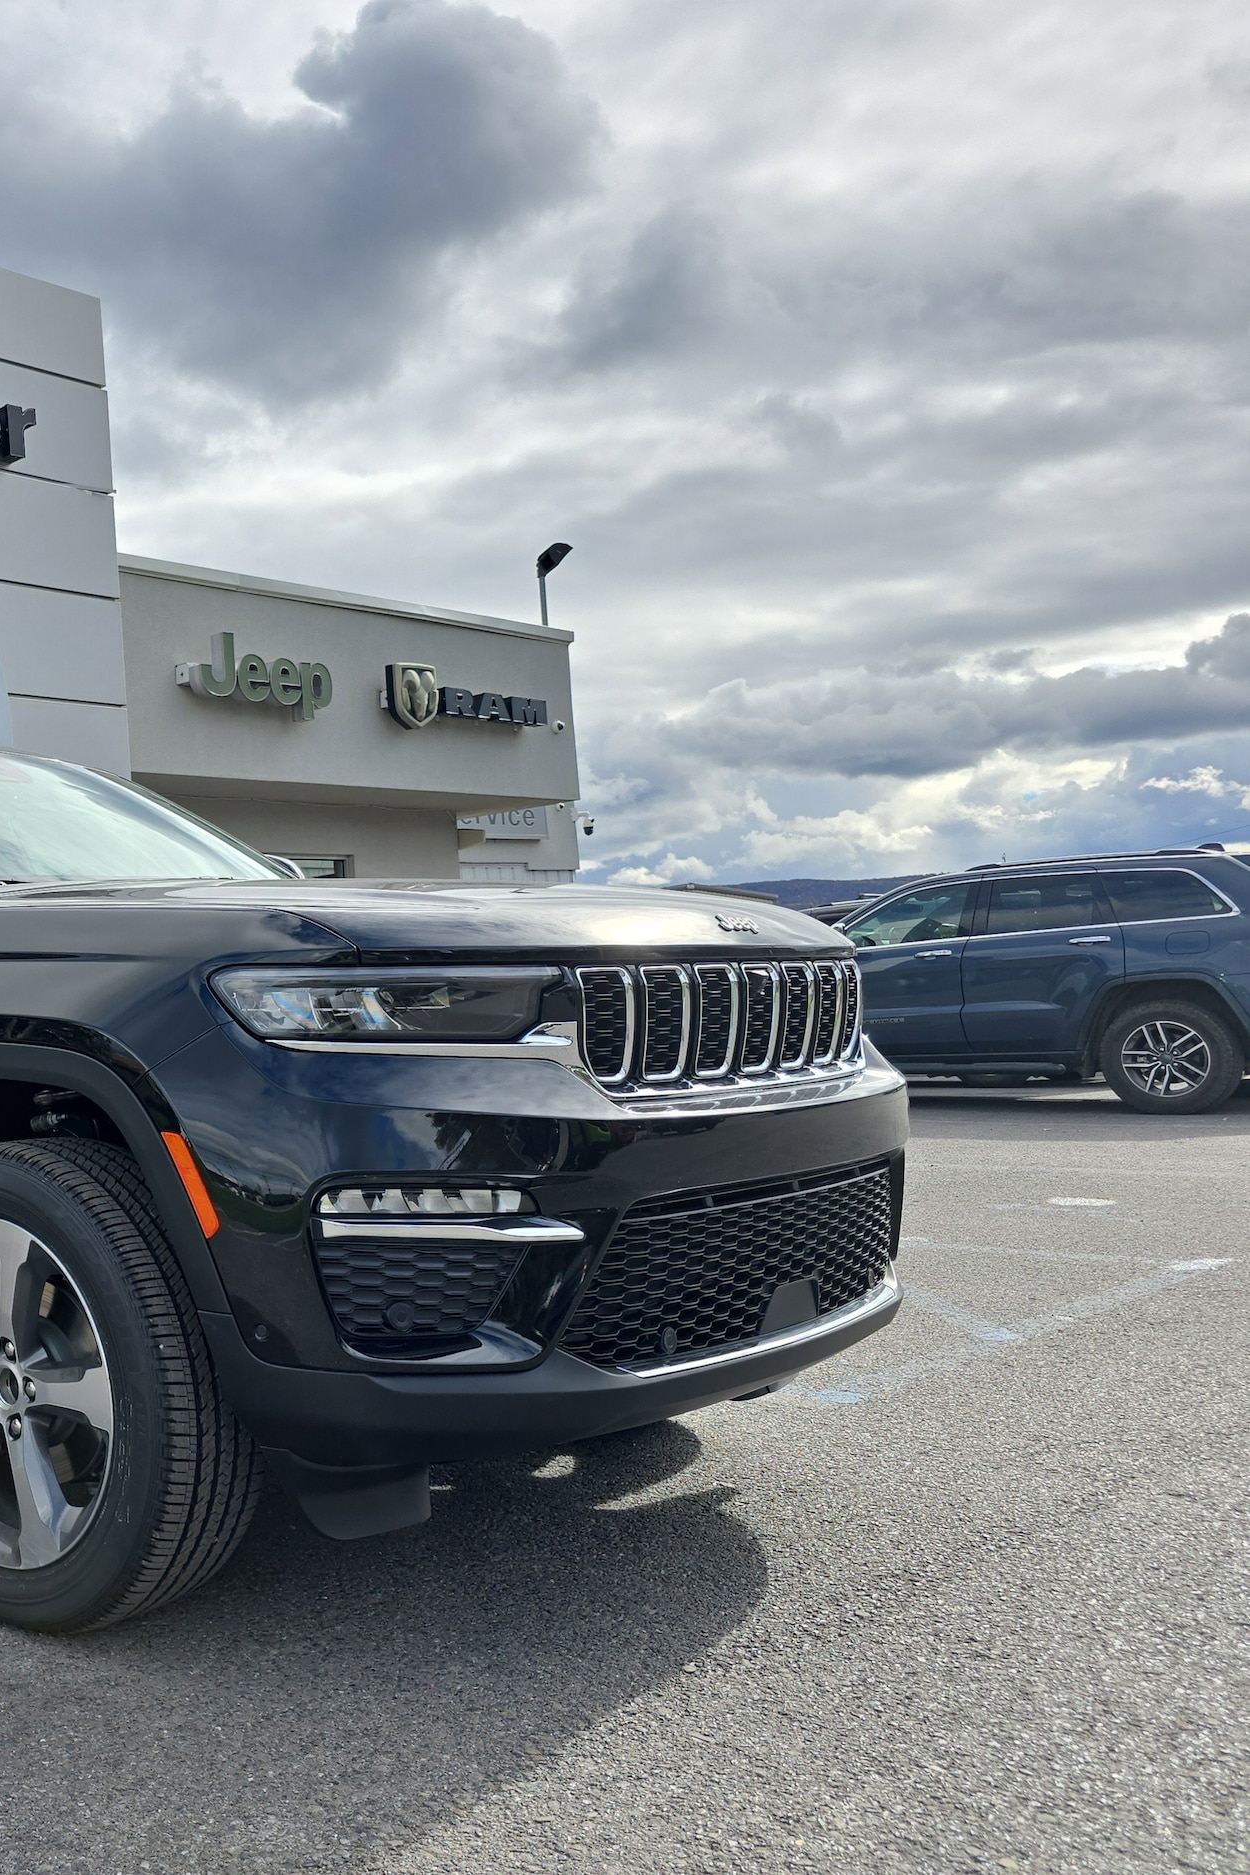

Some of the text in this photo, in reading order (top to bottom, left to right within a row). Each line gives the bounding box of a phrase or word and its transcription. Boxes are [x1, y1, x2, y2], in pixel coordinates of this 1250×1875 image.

[190, 632, 333, 721] Jeep
[439, 687, 548, 727] RAM
[715, 913, 759, 934] Jeep
